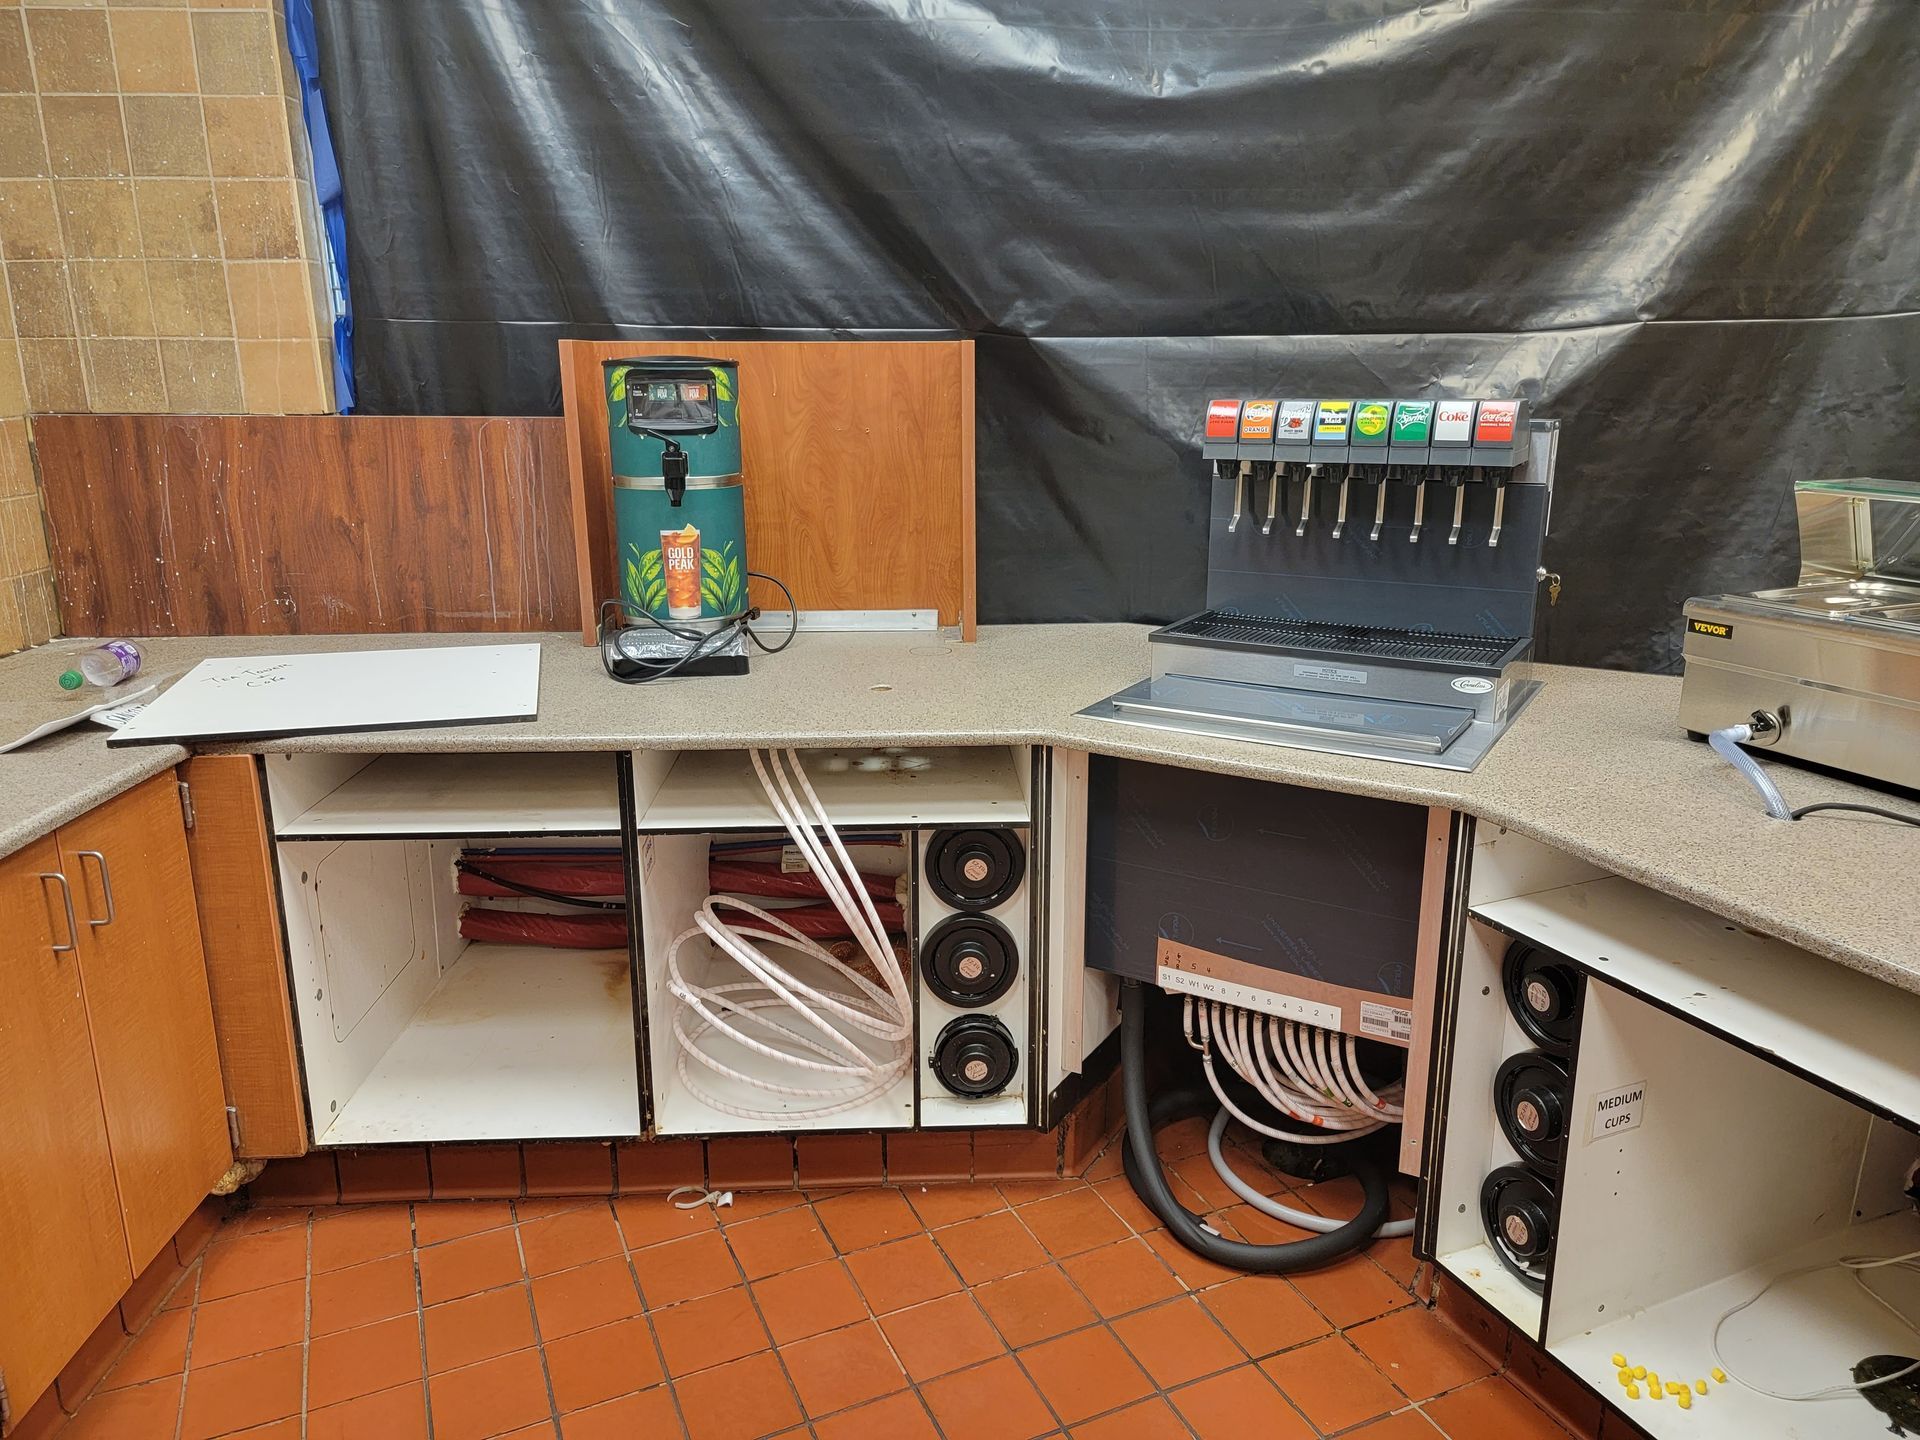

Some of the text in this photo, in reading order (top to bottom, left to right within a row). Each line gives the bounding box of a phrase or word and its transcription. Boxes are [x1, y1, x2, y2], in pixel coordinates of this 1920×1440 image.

[1402, 412, 1427, 424] Sprite
[1439, 411, 1469, 421] Coke
[1480, 411, 1513, 422] Coca-Cola
[668, 547, 694, 559] GOLD
[668, 558, 695, 570] PEAK
[1694, 622, 1726, 636] VEVOR
[1162, 973, 1171, 981] S1
[1175, 976, 1185, 985] S2
[1189, 979, 1200, 988] W1
[1203, 983, 1215, 992] W2
[1598, 1090, 1643, 1112] MEDIUM
[1605, 1112, 1631, 1129] CUPS
